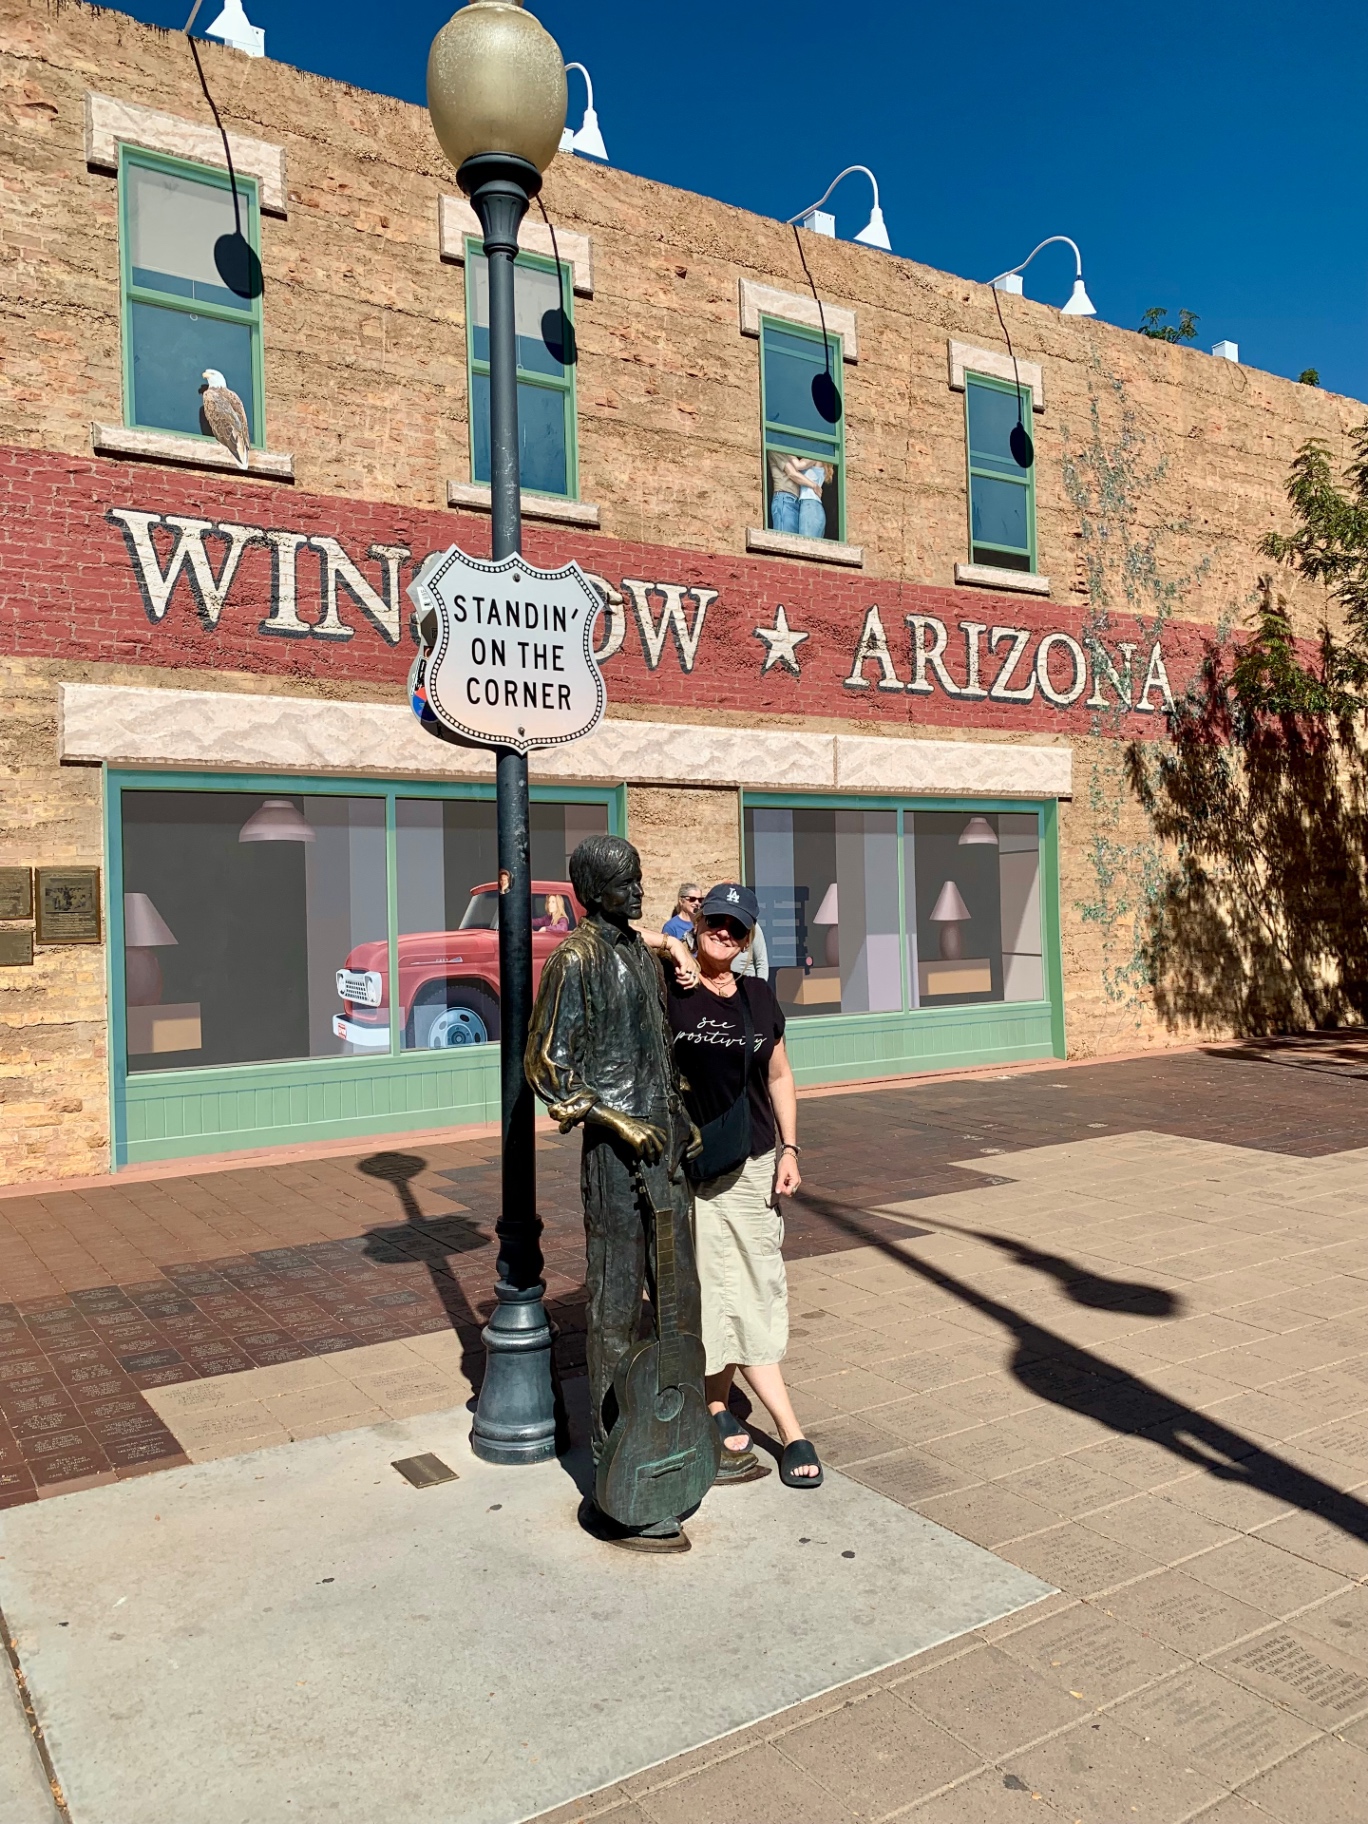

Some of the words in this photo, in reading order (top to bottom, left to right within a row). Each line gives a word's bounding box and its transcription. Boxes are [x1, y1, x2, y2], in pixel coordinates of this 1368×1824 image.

[453, 594, 579, 632] STANDIN'
[471, 637, 506, 667] ON
[517, 641, 565, 672] THE
[843, 604, 1176, 713] ARIZONA
[466, 677, 571, 710] CORNER
[727, 887, 740, 903] LA
[697, 1017, 736, 1029] see
[673, 1030, 767, 1053] positiviy
